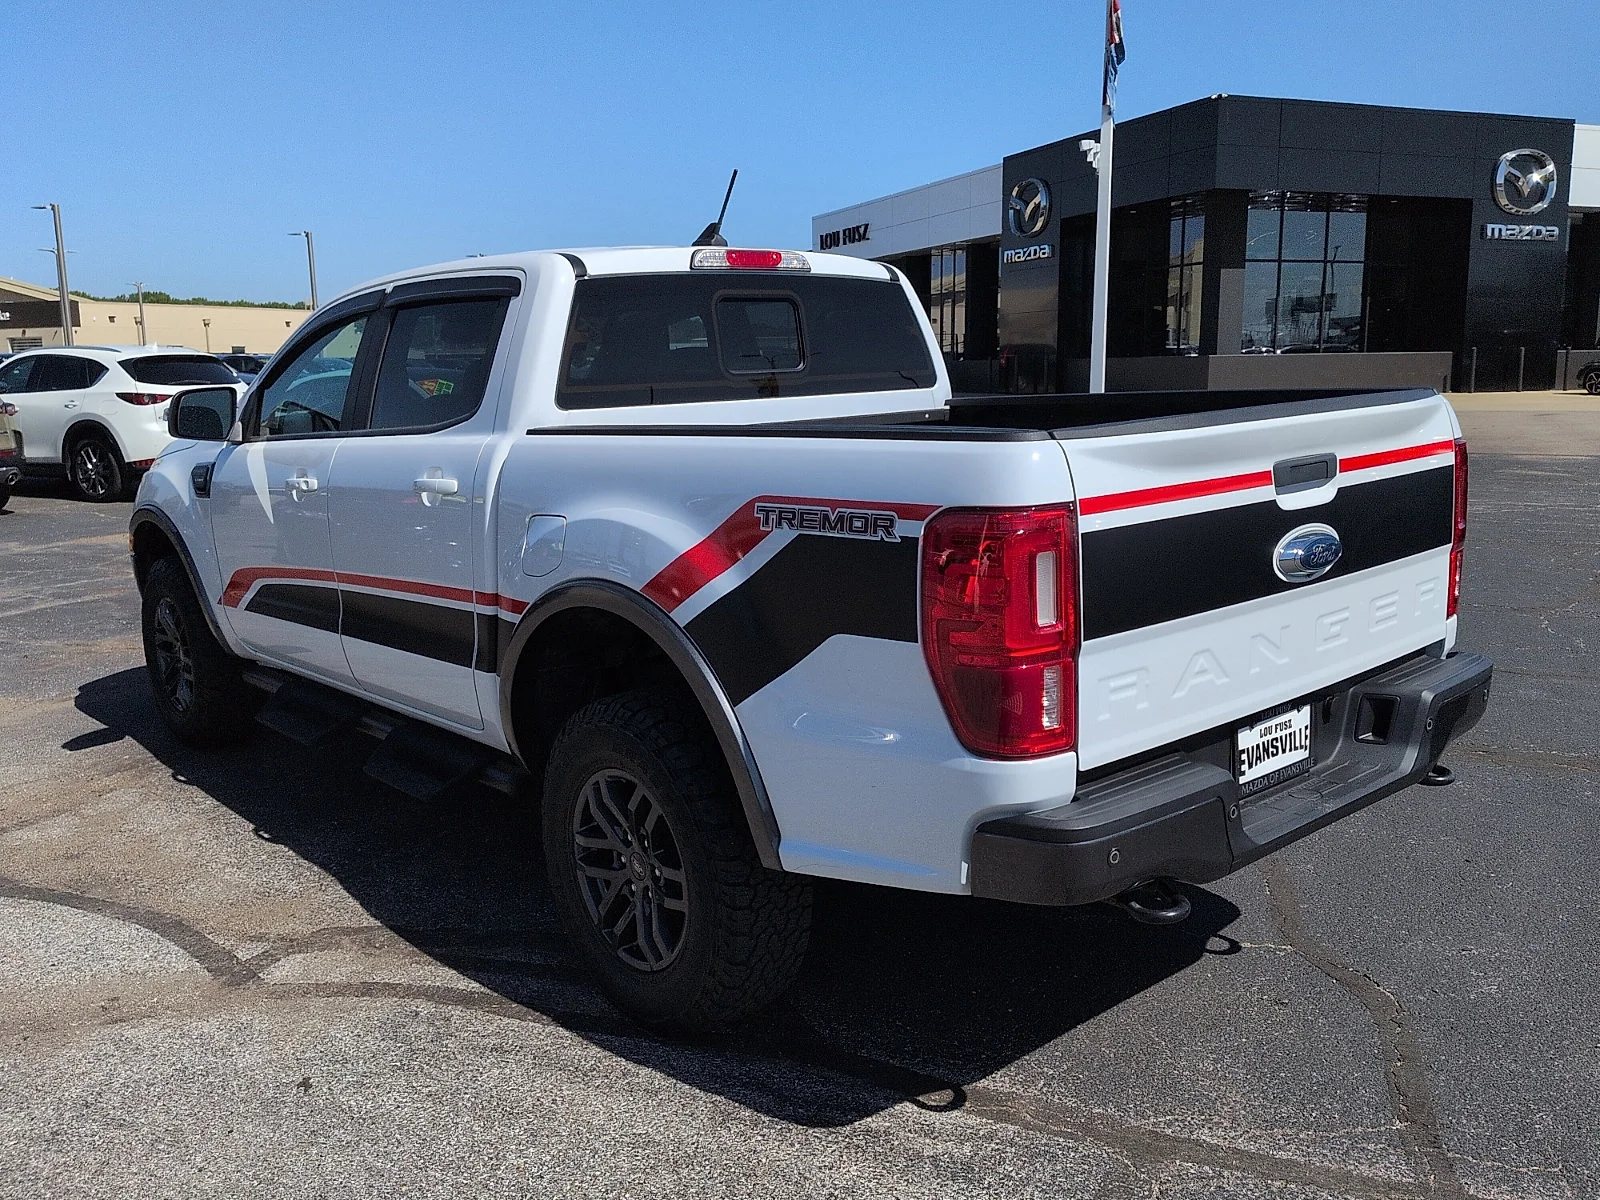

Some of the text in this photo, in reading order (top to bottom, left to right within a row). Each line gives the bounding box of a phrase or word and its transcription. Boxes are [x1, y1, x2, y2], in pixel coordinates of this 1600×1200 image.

[820, 222, 871, 251] LOU FUSZ
[1486, 222, 1559, 241] mazda
[1003, 244, 1052, 264] mazda
[754, 502, 901, 543] TREMOR
[1310, 543, 1336, 566] Ford
[1097, 576, 1442, 722] RANGER
[1259, 718, 1292, 739] LOU FUSZ
[1239, 724, 1309, 777] EVANSVILLE
[1241, 757, 1315, 795] MAZDA OF EVANSVILLE
